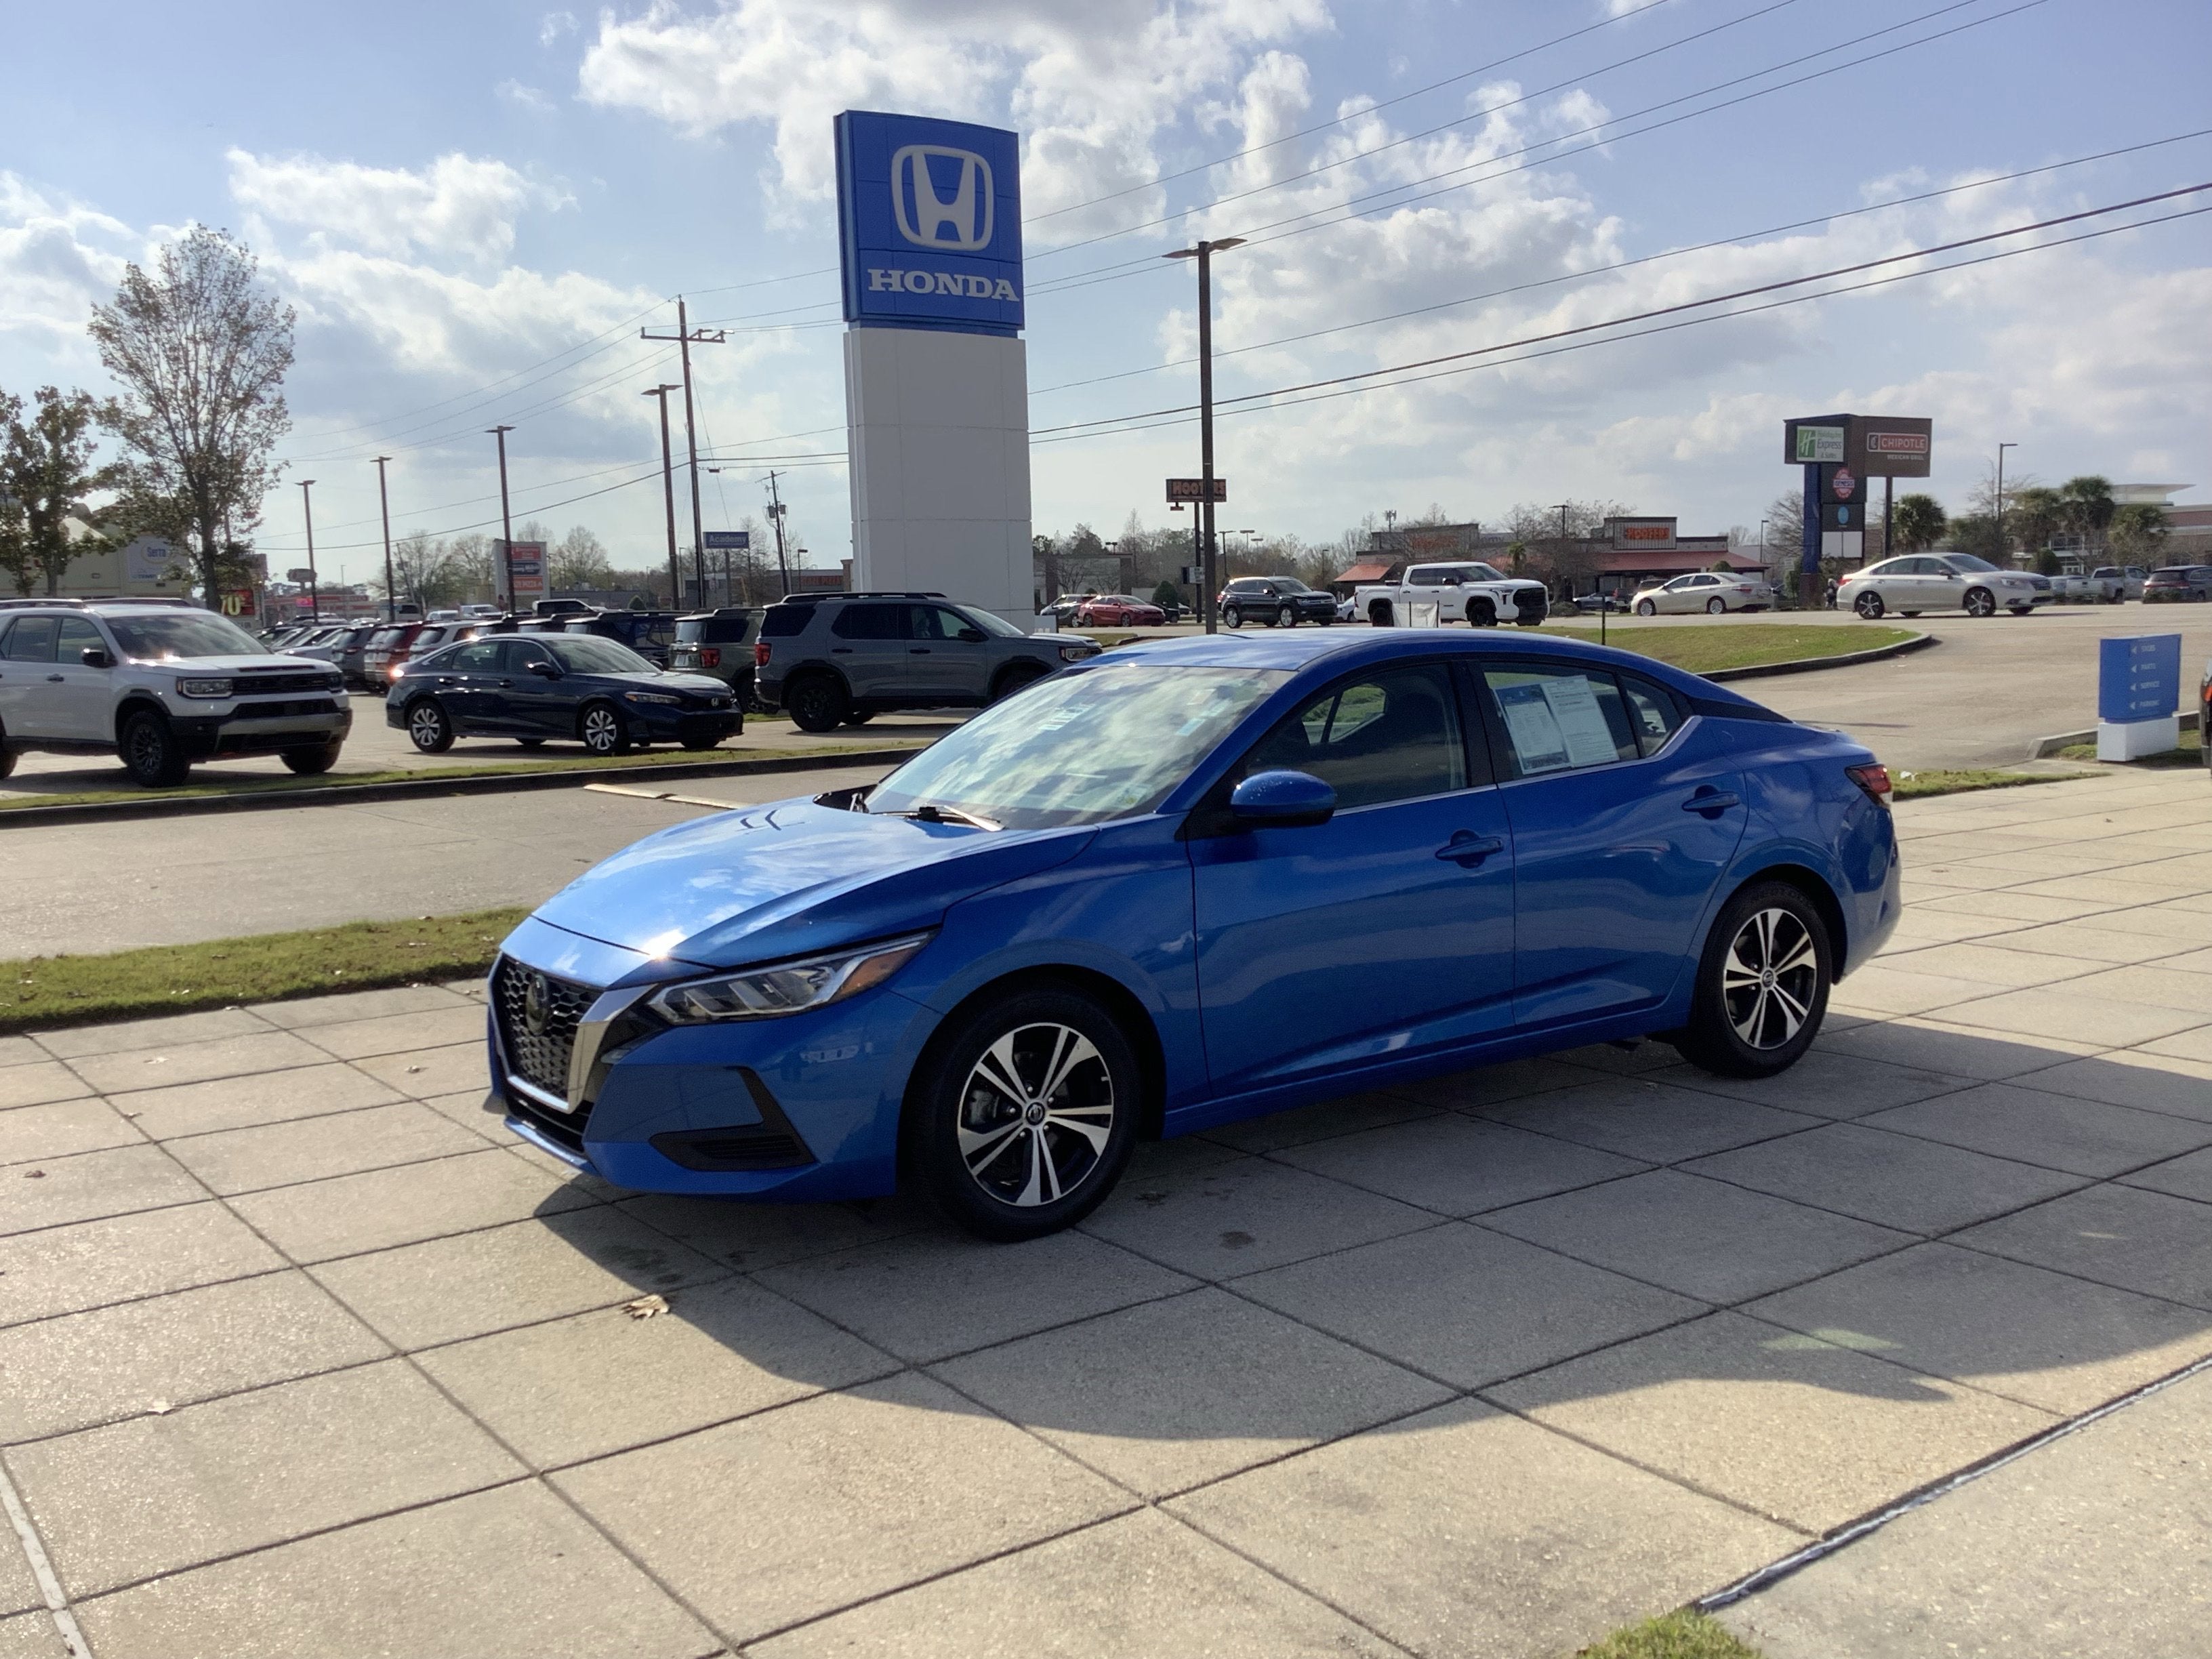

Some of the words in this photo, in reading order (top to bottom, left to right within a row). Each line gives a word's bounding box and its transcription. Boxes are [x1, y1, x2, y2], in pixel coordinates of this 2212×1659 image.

[867, 268, 1020, 302] HONDA
[1817, 438, 1842, 451] Express
[1881, 438, 1925, 449] CHIPOTLE
[709, 534, 747, 545] Academy
